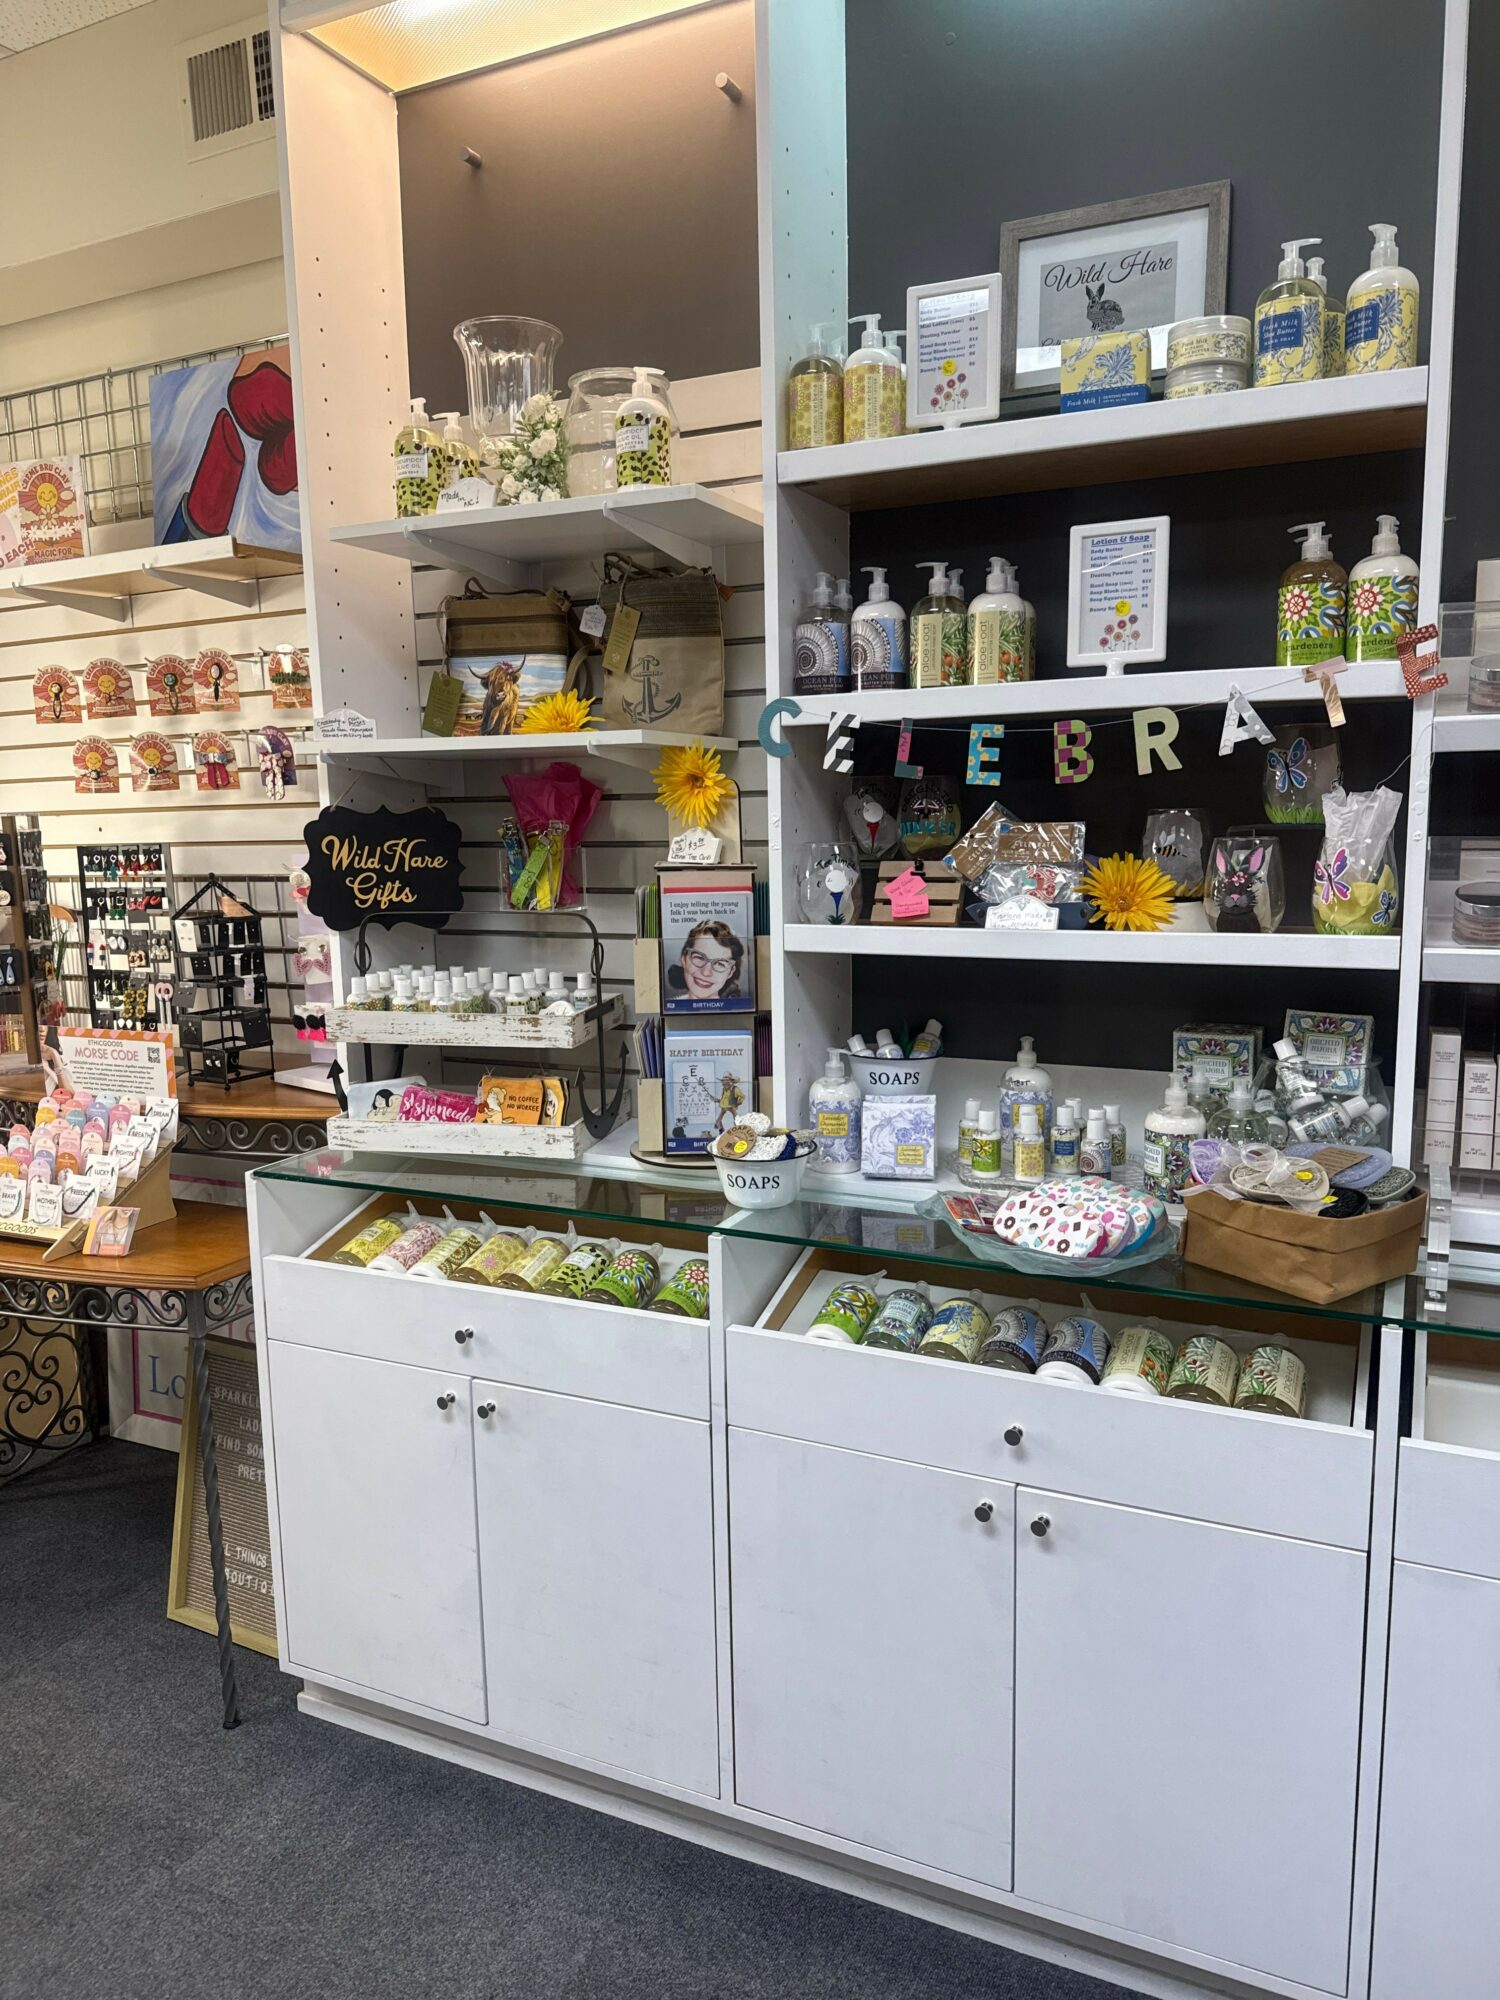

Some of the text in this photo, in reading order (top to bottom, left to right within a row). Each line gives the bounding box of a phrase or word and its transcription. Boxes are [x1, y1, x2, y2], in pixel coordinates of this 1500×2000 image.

[1044, 250, 1173, 292] Wild Hare
[1281, 319, 1298, 327] Milk
[1067, 399, 1081, 407] Fresh
[1083, 397, 1096, 406] Milk
[22, 464, 71, 489] CREME BRU CLAY
[1091, 538, 1118, 546] Lotion
[1129, 534, 1150, 542] Soap
[5, 540, 34, 563] EACH
[34, 548, 72, 558] MAGIC FOR
[62, 670, 75, 684] CLAY
[113, 664, 127, 676] CLAY
[101, 740, 114, 754] CLAY
[159, 736, 172, 750] CLAY
[321, 834, 448, 873] Wild Hare
[346, 872, 417, 910] Gifts
[88, 1040, 124, 1048] ETHICGOODS
[74, 1048, 140, 1062] MORSE CODE
[670, 1048, 744, 1058] HAPPY BIRTHDAY
[869, 1071, 920, 1086] SOAPS
[517, 1104, 540, 1112] WORKEE
[726, 1173, 780, 1190] SOAPS
[2, 1192, 16, 1200] BRAVE
[70, 1188, 92, 1196] FREEDO
[216, 1435, 241, 1450] FIND
[236, 1547, 267, 1568] THINGS
